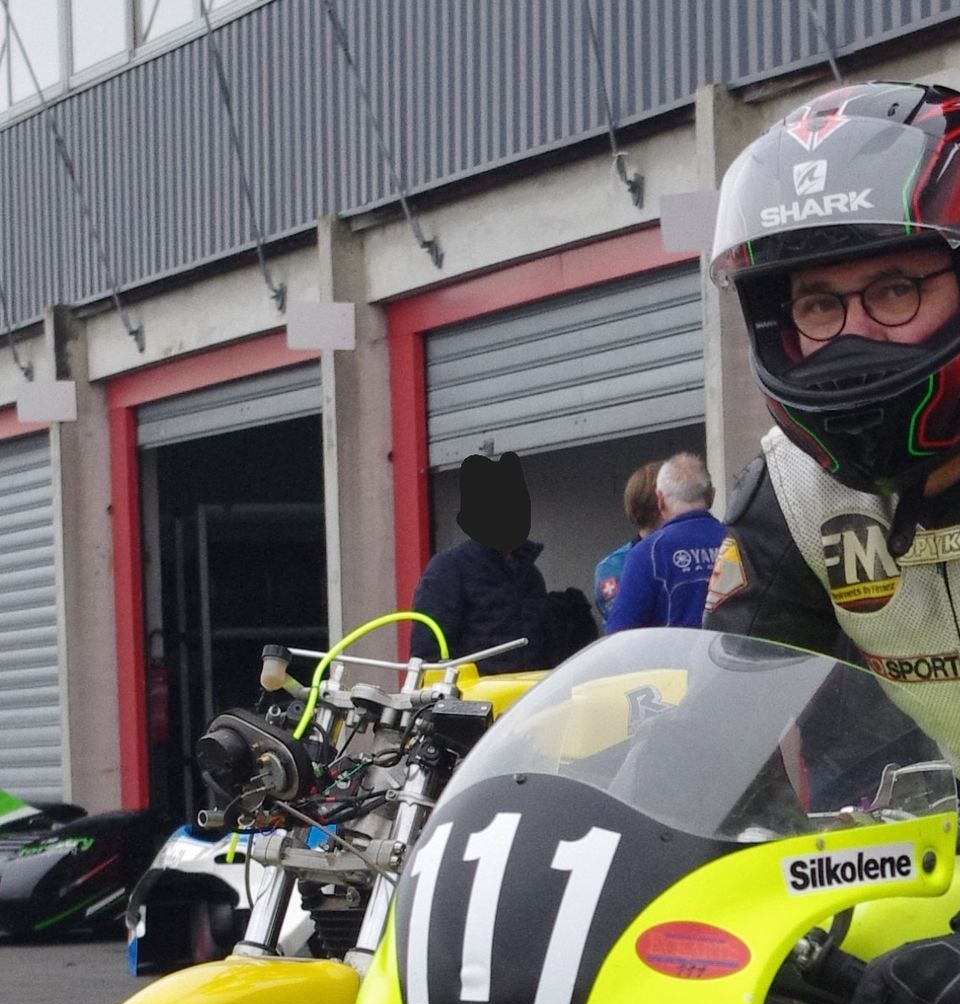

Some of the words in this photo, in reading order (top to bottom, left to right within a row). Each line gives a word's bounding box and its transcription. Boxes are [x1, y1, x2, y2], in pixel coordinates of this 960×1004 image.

[760, 188, 875, 228] SHARK
[690, 547, 719, 563] YAM
[886, 656, 959, 679] SPORT
[790, 855, 912, 892] Silkolene
